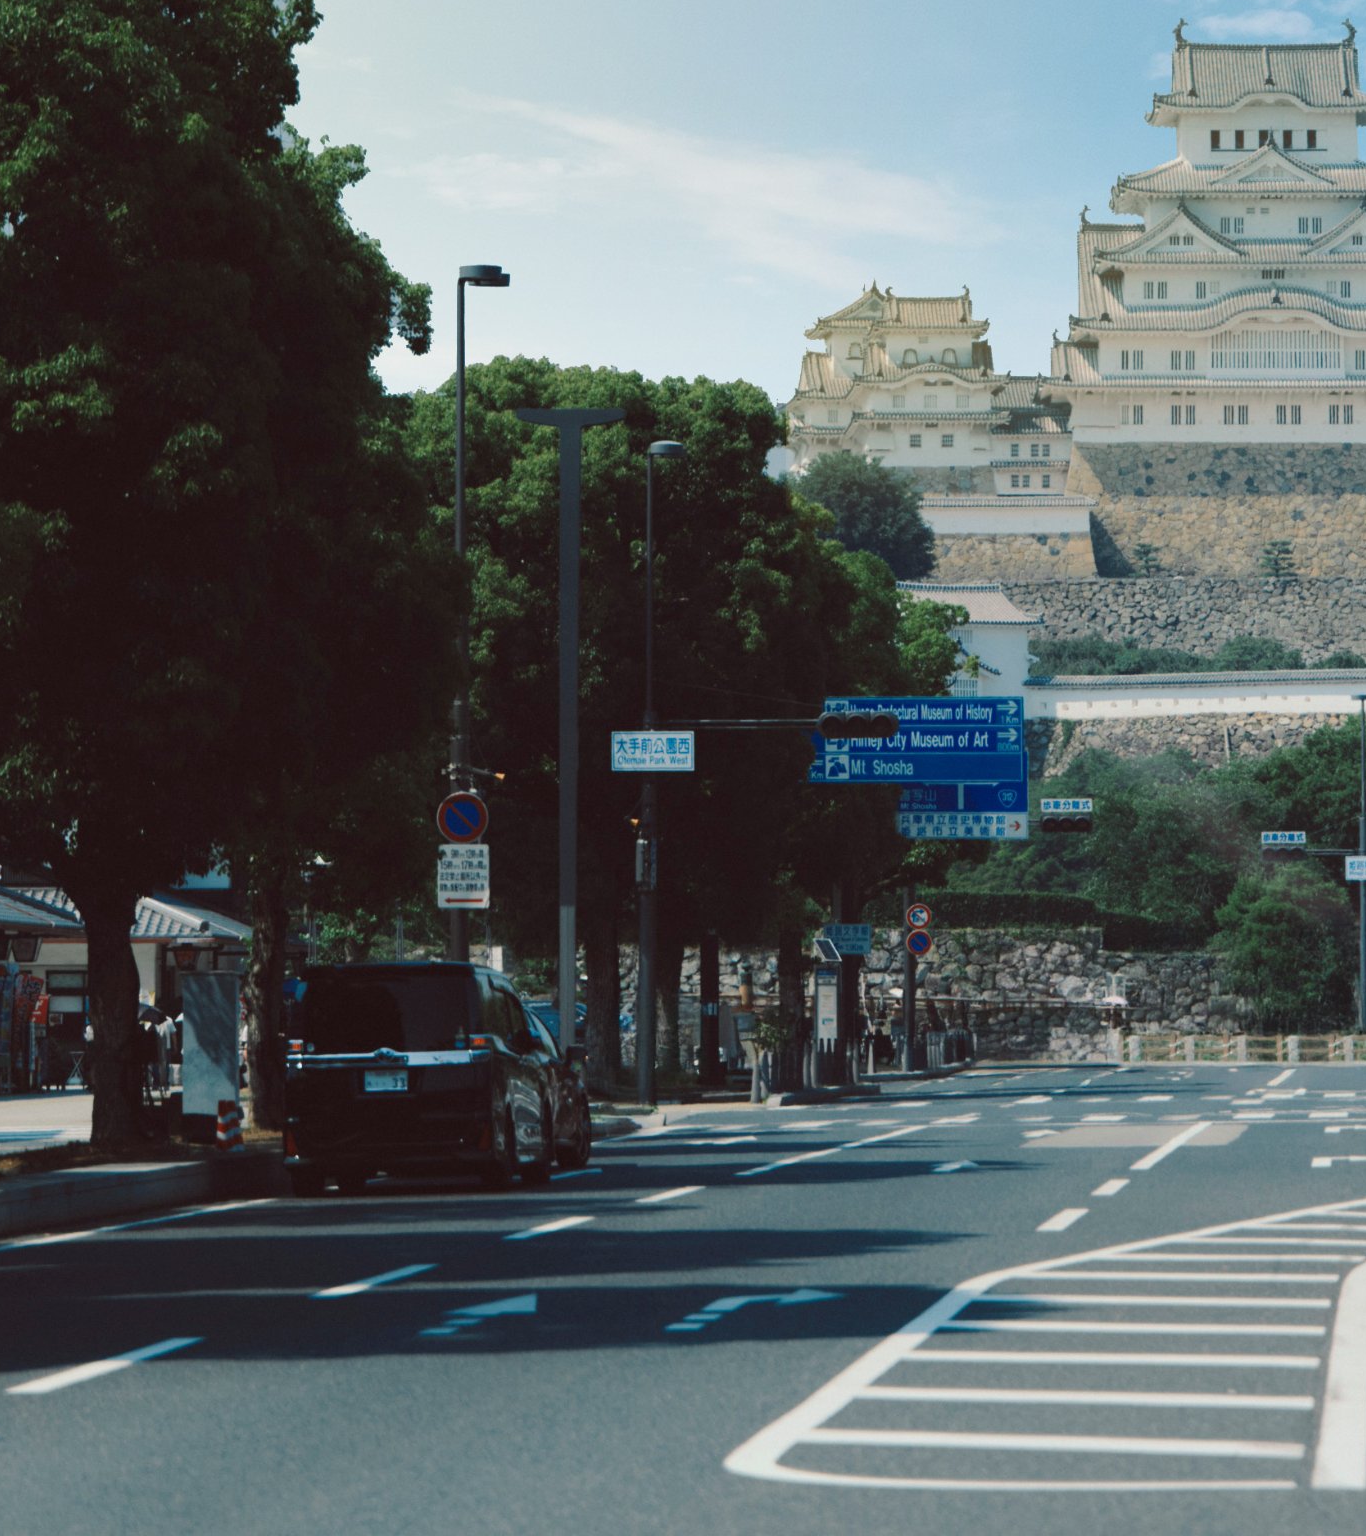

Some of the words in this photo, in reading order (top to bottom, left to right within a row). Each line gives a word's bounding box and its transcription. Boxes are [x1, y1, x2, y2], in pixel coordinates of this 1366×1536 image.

[921, 704, 954, 721] Museum
[956, 704, 965, 721] of
[966, 703, 993, 724] History
[615, 737, 690, 755] 大手前公園西
[886, 732, 906, 751] City
[911, 732, 954, 748] Museum
[958, 732, 969, 748] of
[973, 732, 989, 748] Art
[649, 755, 666, 765] Park
[669, 755, 689, 765] West
[851, 760, 866, 775] Mt
[873, 760, 914, 775] Shosha
[1043, 800, 1092, 811] 歩車分離式
